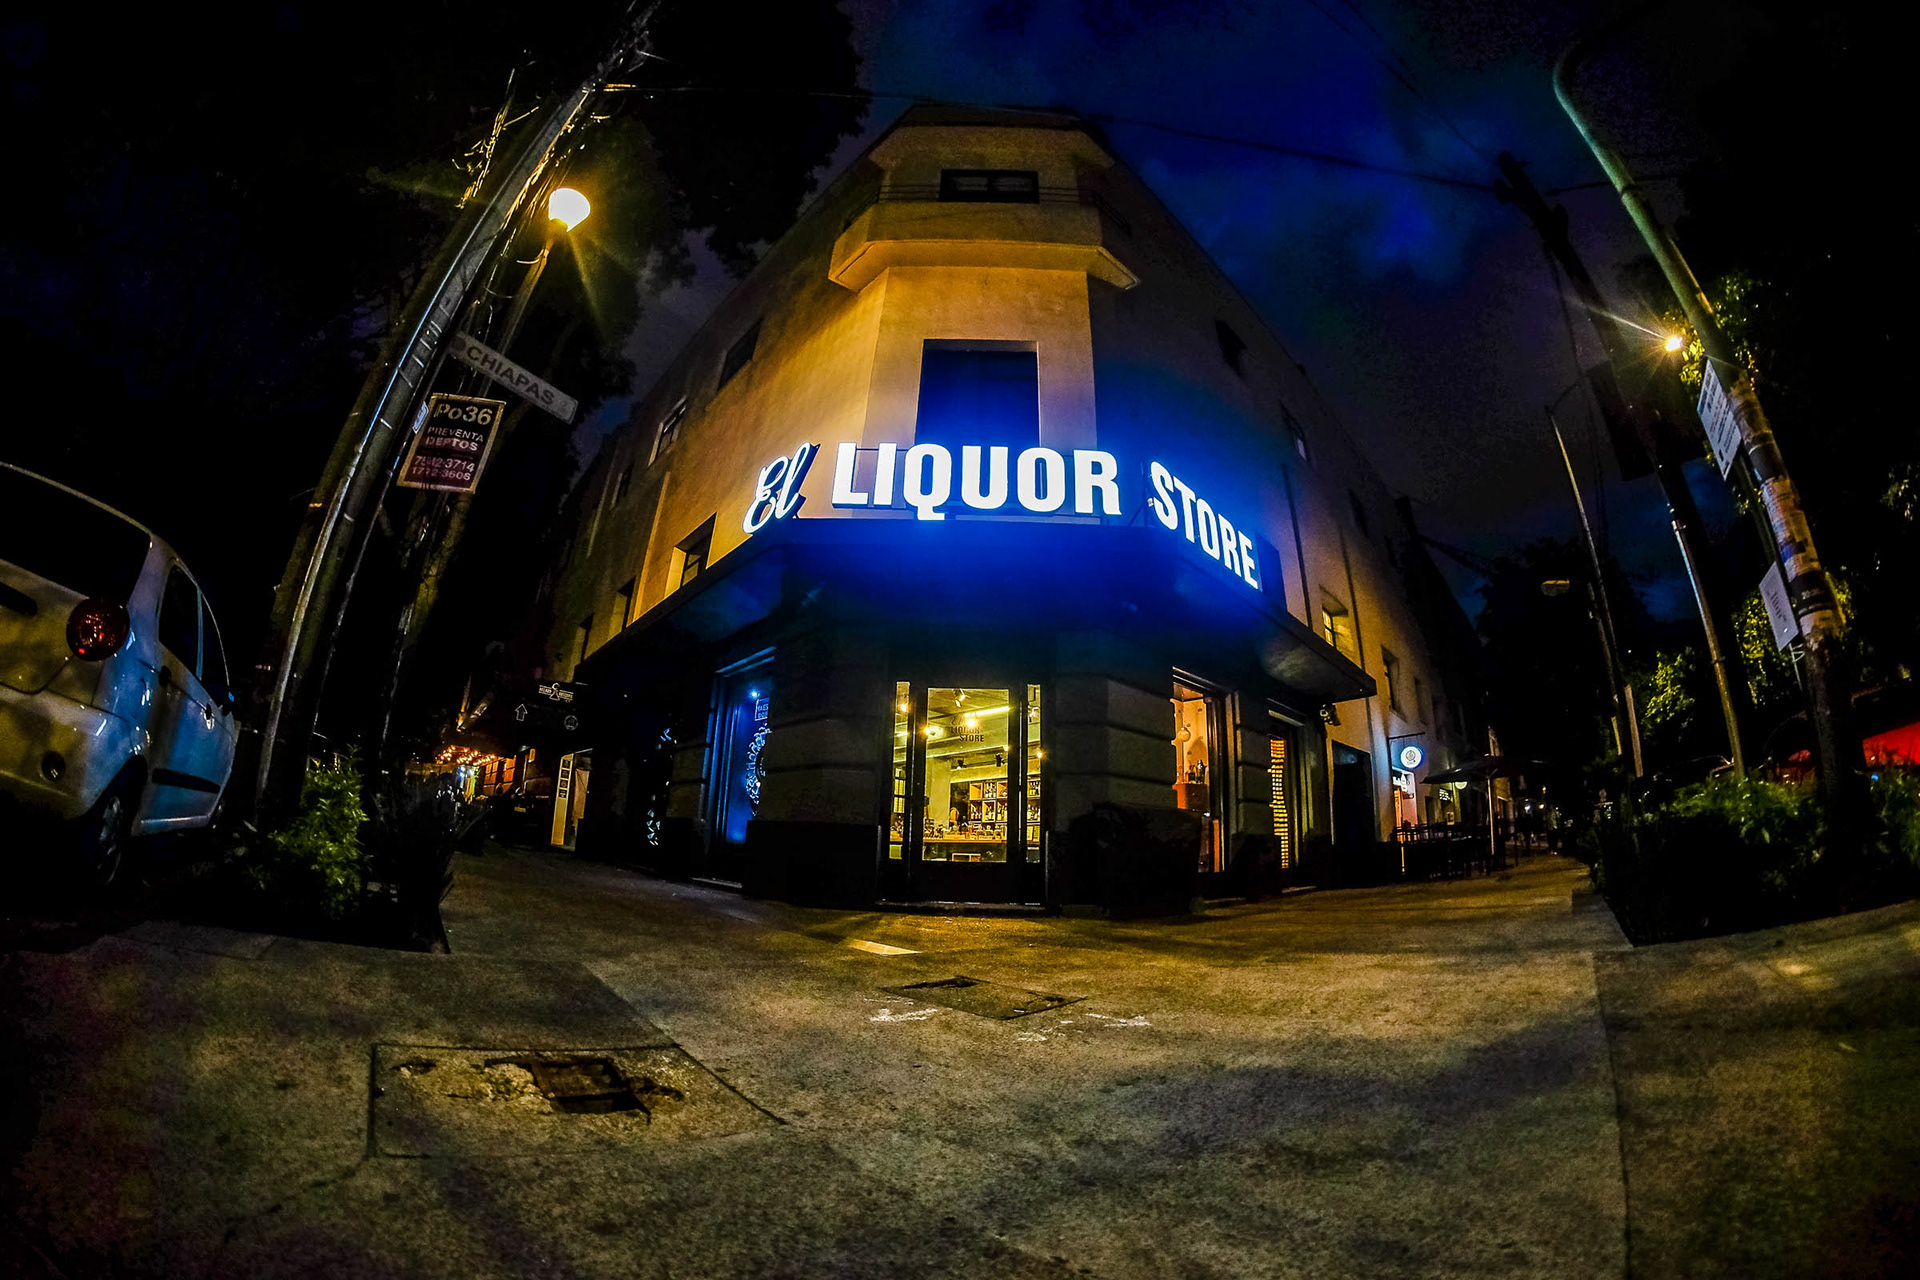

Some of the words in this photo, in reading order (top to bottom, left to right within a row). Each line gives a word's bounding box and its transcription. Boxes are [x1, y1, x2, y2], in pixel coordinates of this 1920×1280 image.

[467, 346, 555, 405] CHIAPAS
[433, 403, 493, 426] Po36
[425, 436, 479, 452] DEPTOS
[427, 427, 484, 443] PREVENTA
[742, 441, 816, 534] El
[831, 442, 1123, 521] LIQUOR
[1149, 461, 1260, 591] STORE
[959, 734, 985, 742] STORE
